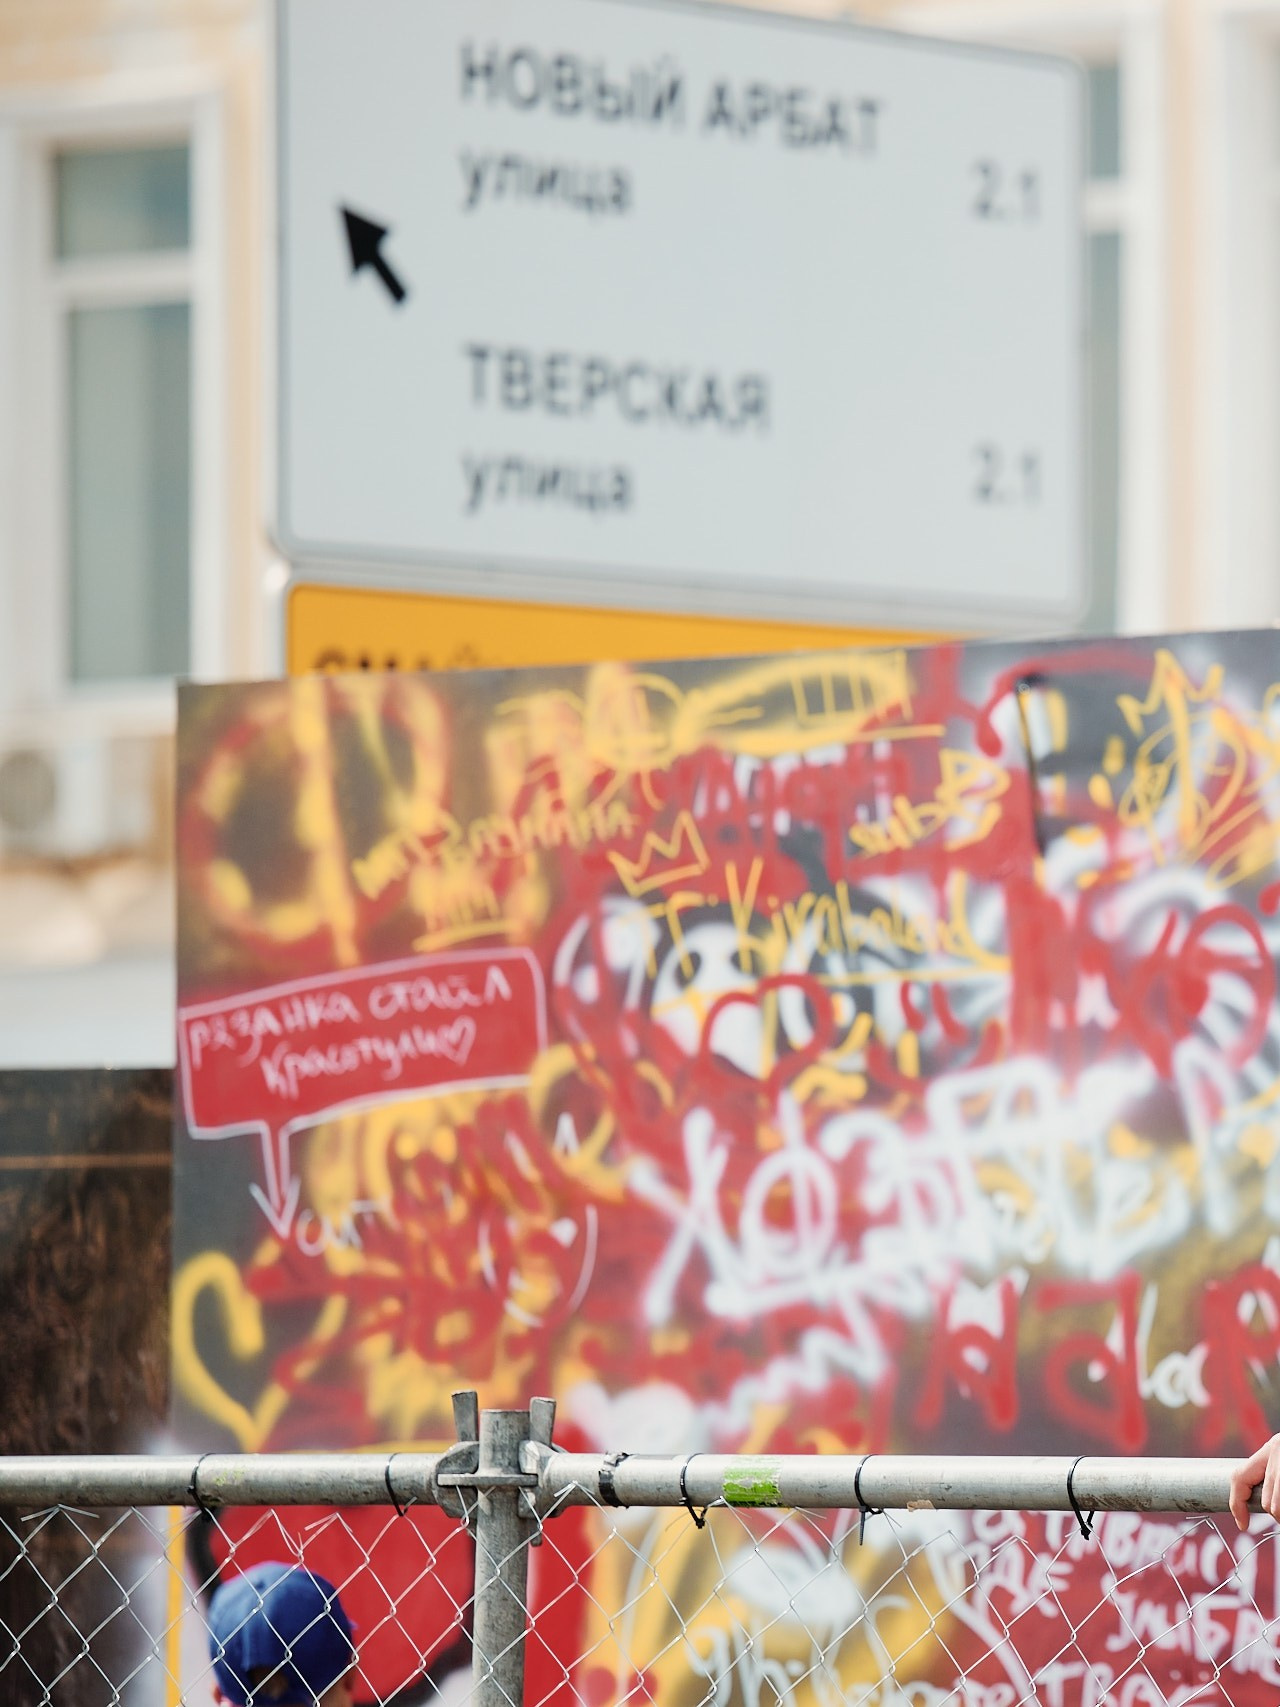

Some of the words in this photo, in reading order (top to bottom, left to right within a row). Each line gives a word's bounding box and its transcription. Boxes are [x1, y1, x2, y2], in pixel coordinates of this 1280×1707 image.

[460, 42, 684, 129] НОВЫЙ
[702, 86, 883, 156] АРБАТ
[460, 149, 632, 214] улица
[974, 160, 1040, 221] 2.1
[465, 342, 770, 434] ТВЕРСКАЯ
[460, 450, 634, 514] улица
[974, 444, 1040, 505] 2.1
